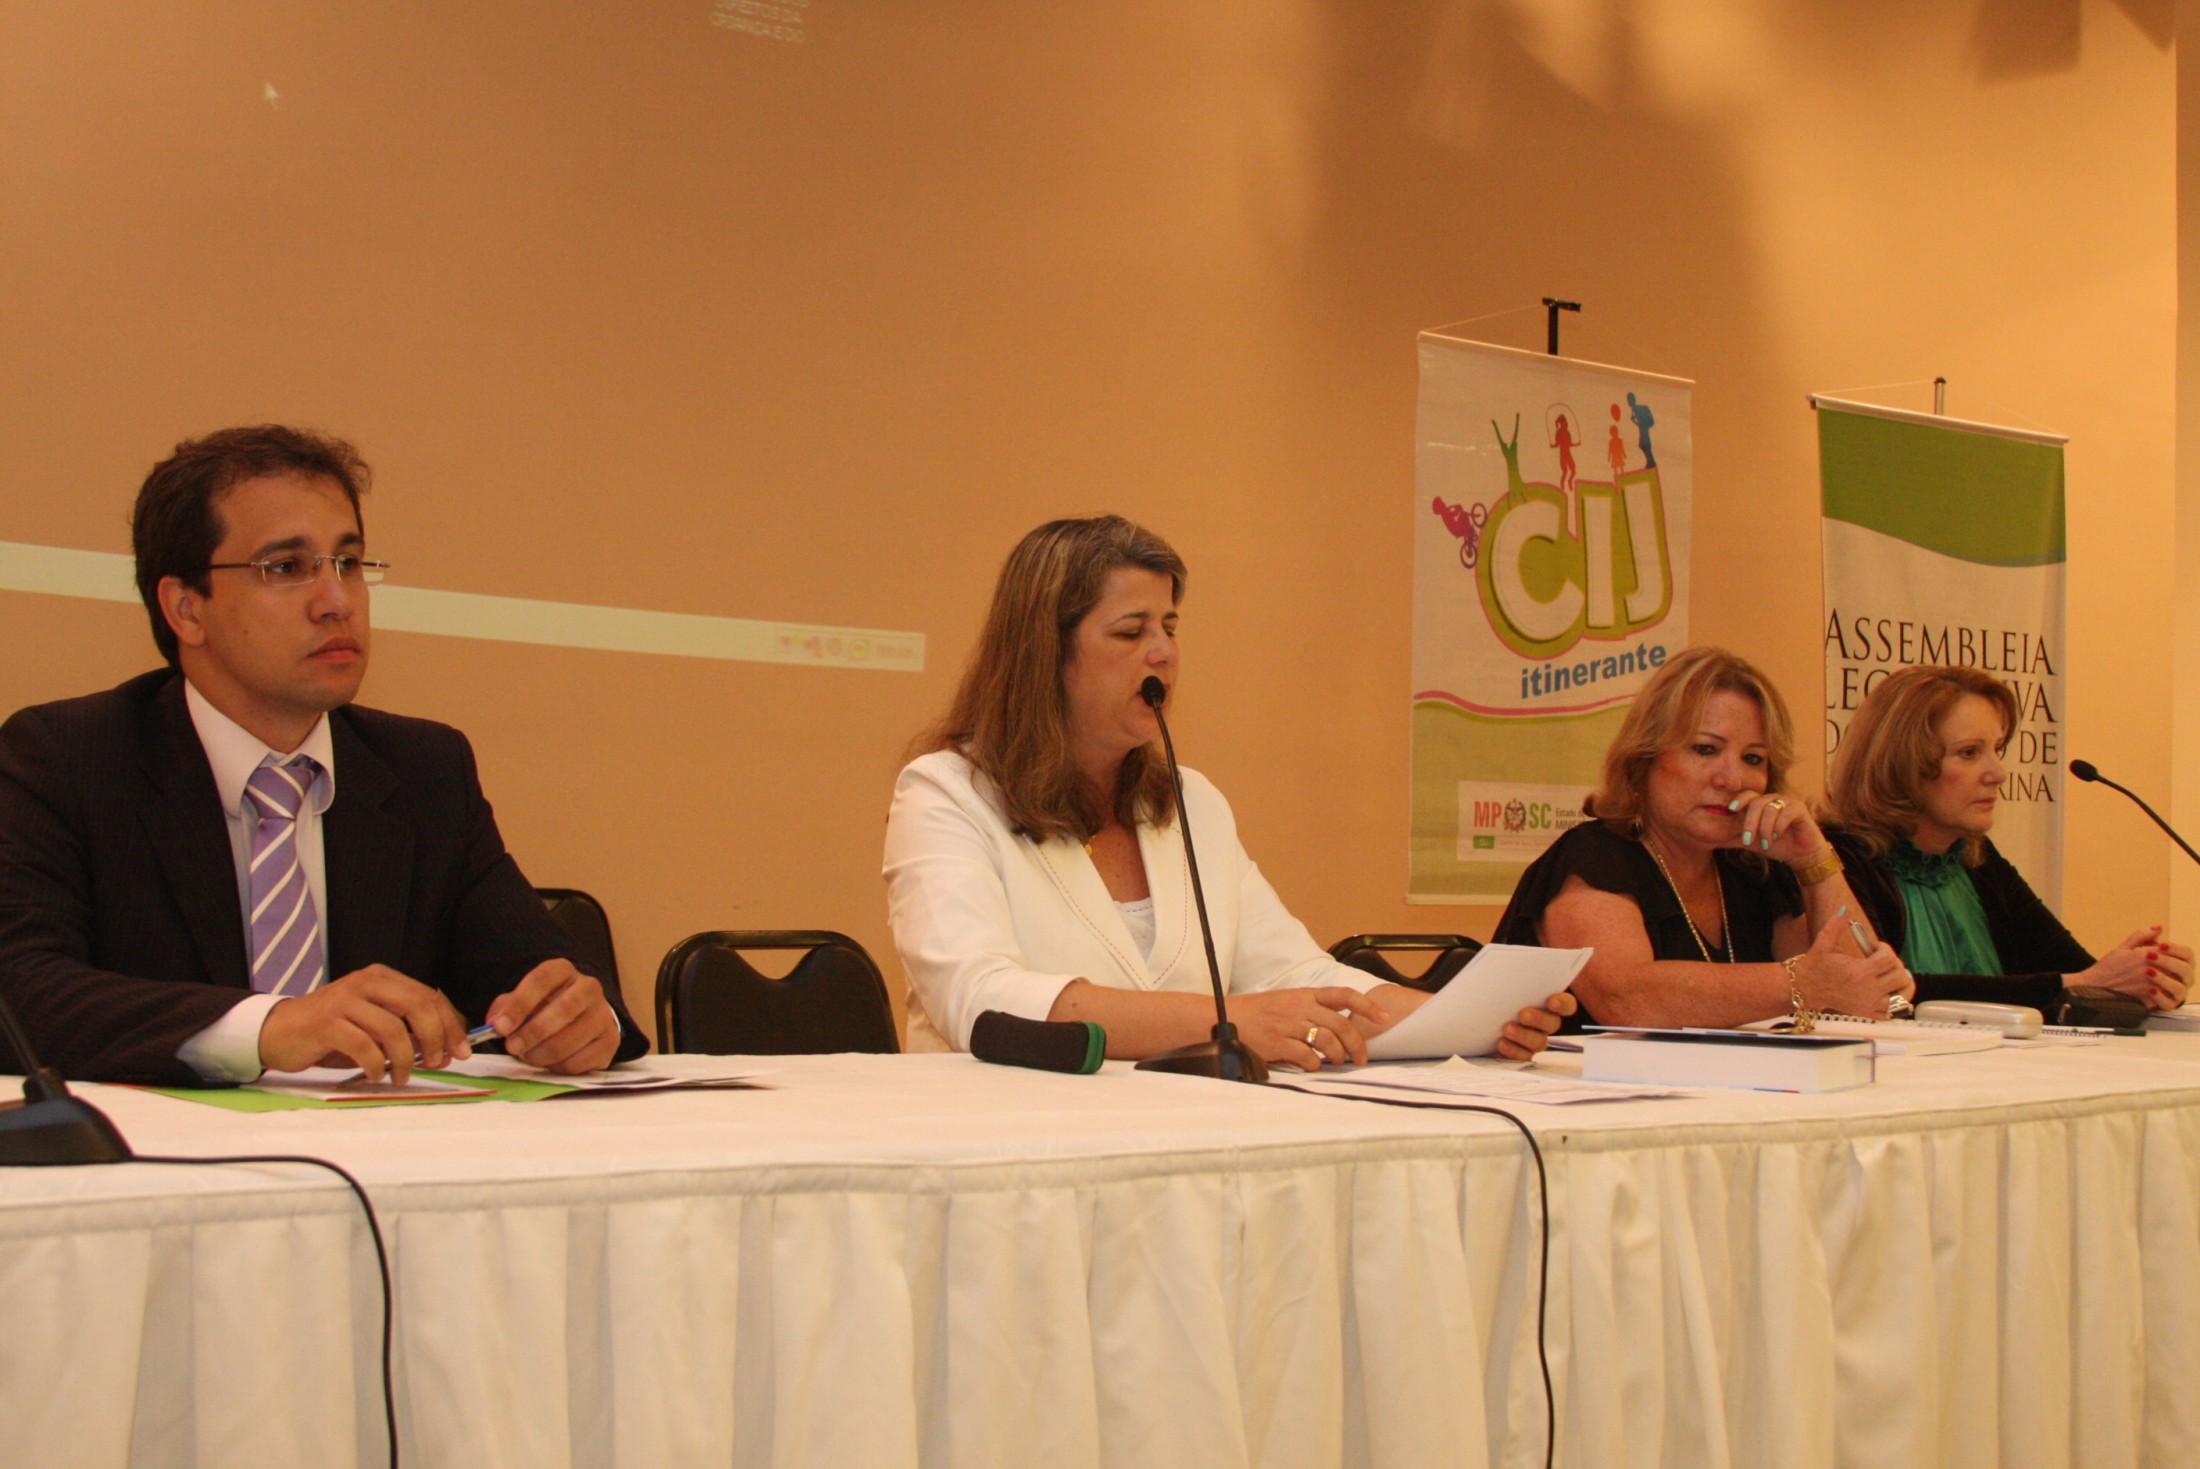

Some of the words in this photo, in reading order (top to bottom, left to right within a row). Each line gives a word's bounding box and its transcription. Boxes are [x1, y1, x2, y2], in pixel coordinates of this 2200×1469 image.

[1488, 479, 1665, 644] CIJ
[1826, 607, 2057, 675] ASSEMBLEIA
[1521, 642, 1666, 699] itinerante
[2019, 730, 2057, 765] DE
[1474, 801, 1502, 828] MP
[1529, 803, 1552, 830] SC
